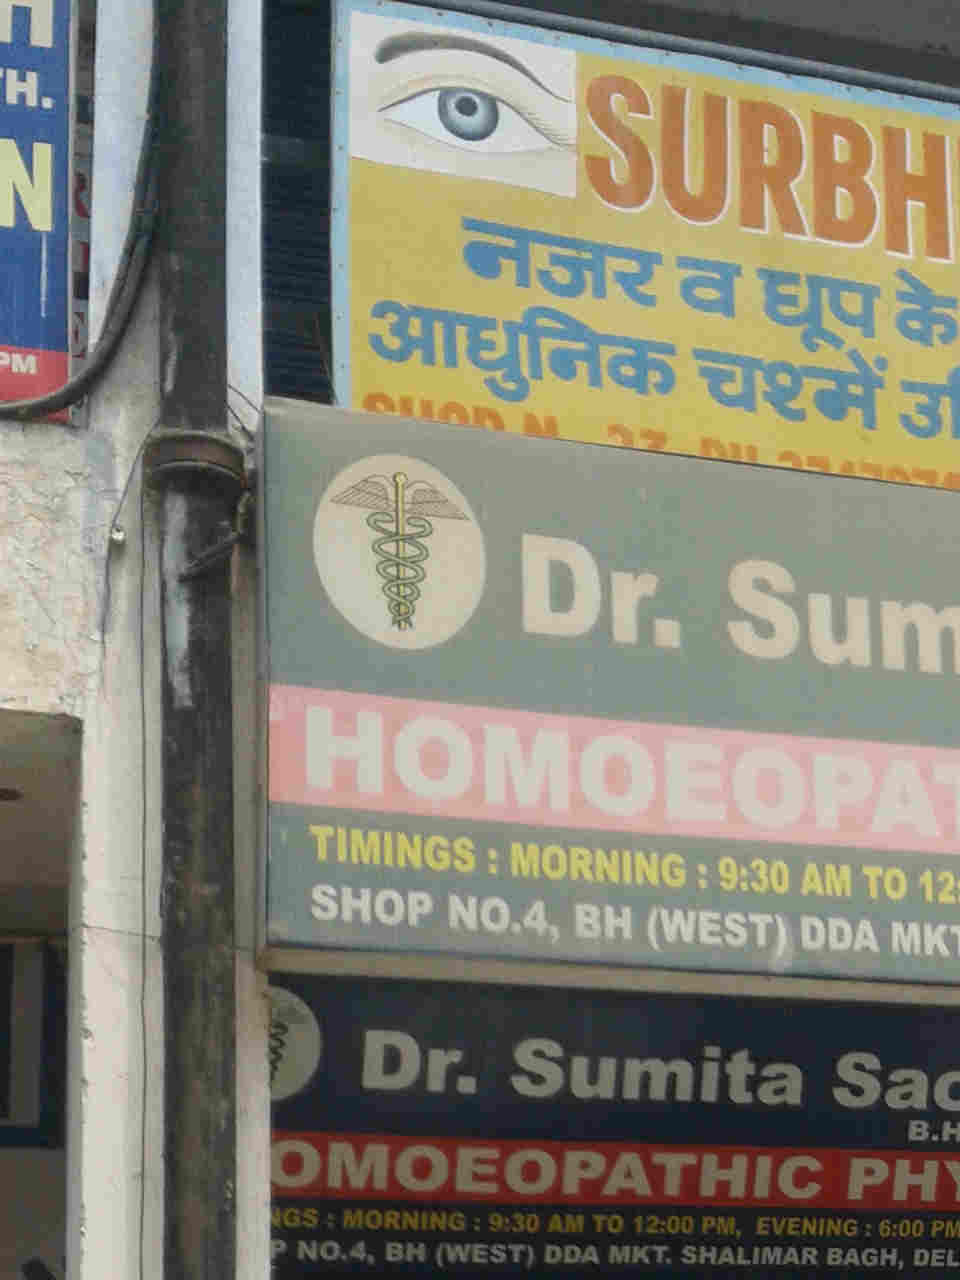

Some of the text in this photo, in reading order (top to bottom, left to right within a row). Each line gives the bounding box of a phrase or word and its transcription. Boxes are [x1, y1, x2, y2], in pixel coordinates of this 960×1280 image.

[460, 215, 663, 307] नजर
[676, 255, 742, 318] व
[893, 268, 958, 348] के
[368, 300, 677, 403] आधुनिक
[521, 532, 682, 648] Dr.
[718, 857, 790, 894] 9:30
[802, 864, 851, 897] AM
[864, 866, 908, 899] TO
[311, 884, 434, 928] SHOP
[574, 903, 633, 940] BH
[647, 907, 788, 958] (WEST)
[800, 917, 881, 954] DDA
[361, 1028, 478, 1095] Dr.
[510, 1037, 803, 1107] Sumita
[385, 1241, 425, 1263] BH
[435, 1242, 535, 1269] (WEST)
[544, 1244, 600, 1265] DDA
[608, 1245, 672, 1266] MKT.
[681, 1245, 819, 1267] SHALIMAR
[826, 1247, 904, 1271] BAGH,
[488, 1213, 540, 1233] 9:30
[549, 1213, 584, 1233] AM
[592, 1214, 624, 1233] TO
[633, 1215, 694, 1234] 12:00
[879, 1219, 924, 1238] 6:00
[932, 1220, 960, 1239] PM
